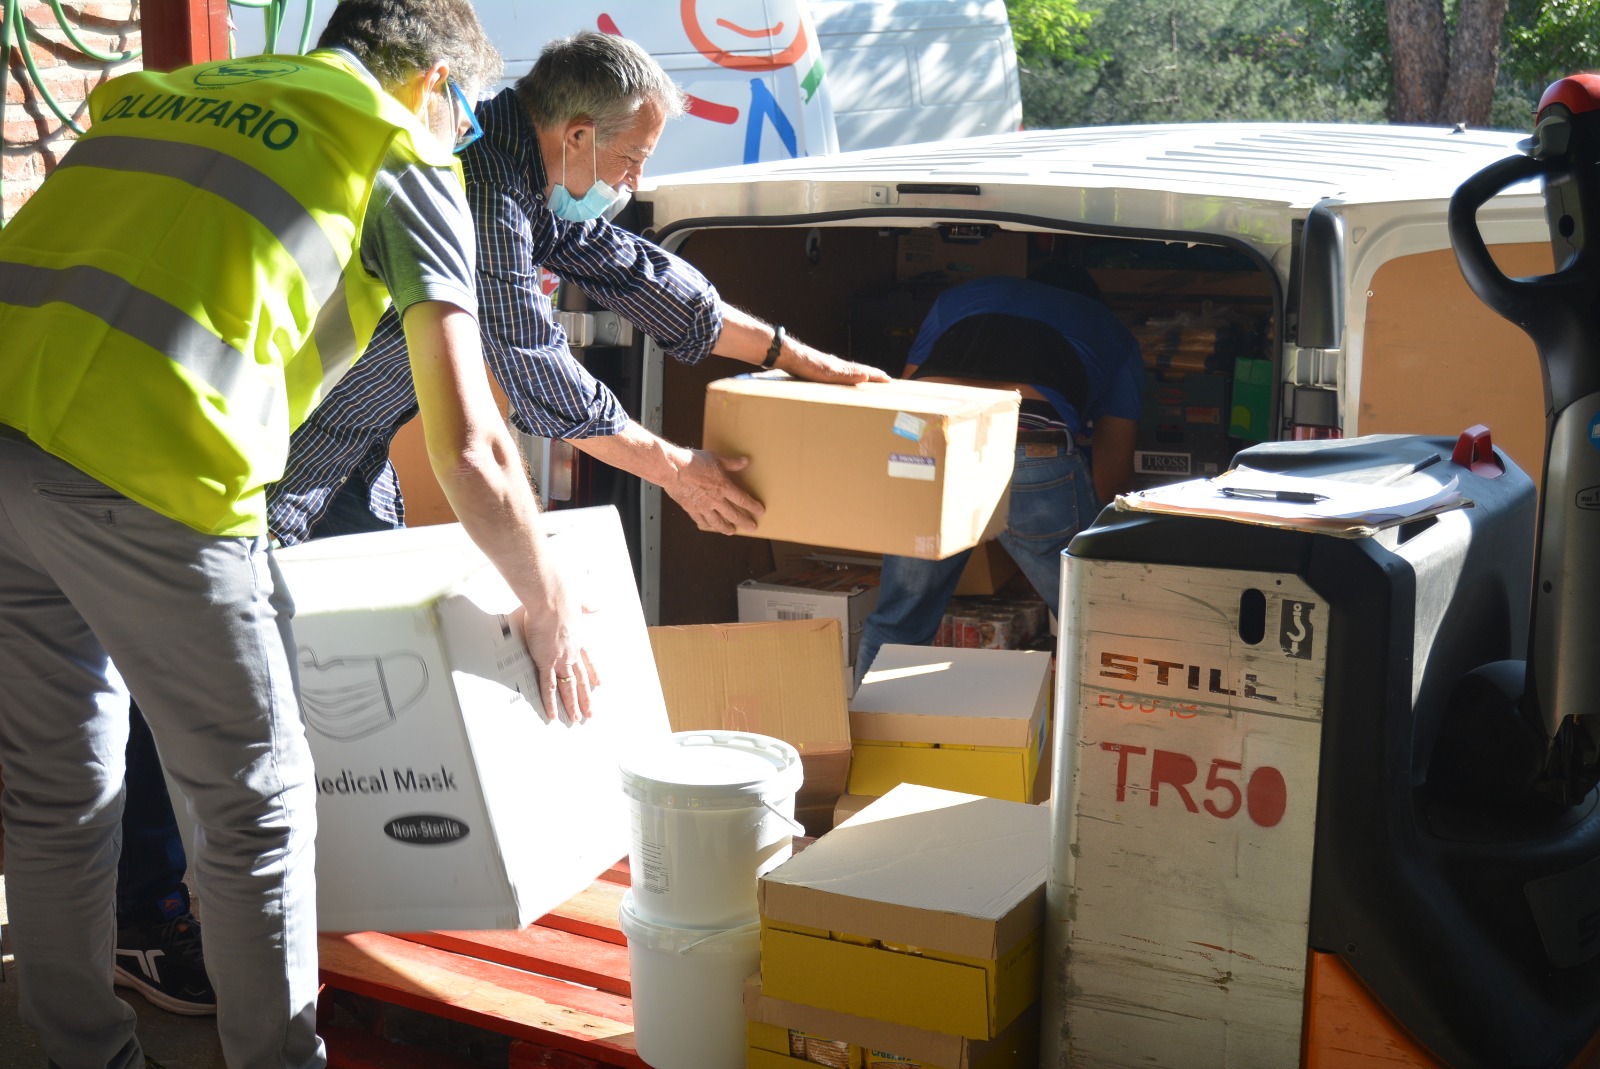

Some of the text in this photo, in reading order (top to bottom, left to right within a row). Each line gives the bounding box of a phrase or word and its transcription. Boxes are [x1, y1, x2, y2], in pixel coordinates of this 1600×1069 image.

[102, 94, 299, 150] OLUNTARIO
[1145, 455, 1186, 467] TROSS
[1100, 652, 1277, 701] STILL
[315, 763, 457, 796] edical Mask
[1101, 742, 1287, 827] TR50
[391, 819, 461, 839] Non-Sterile
